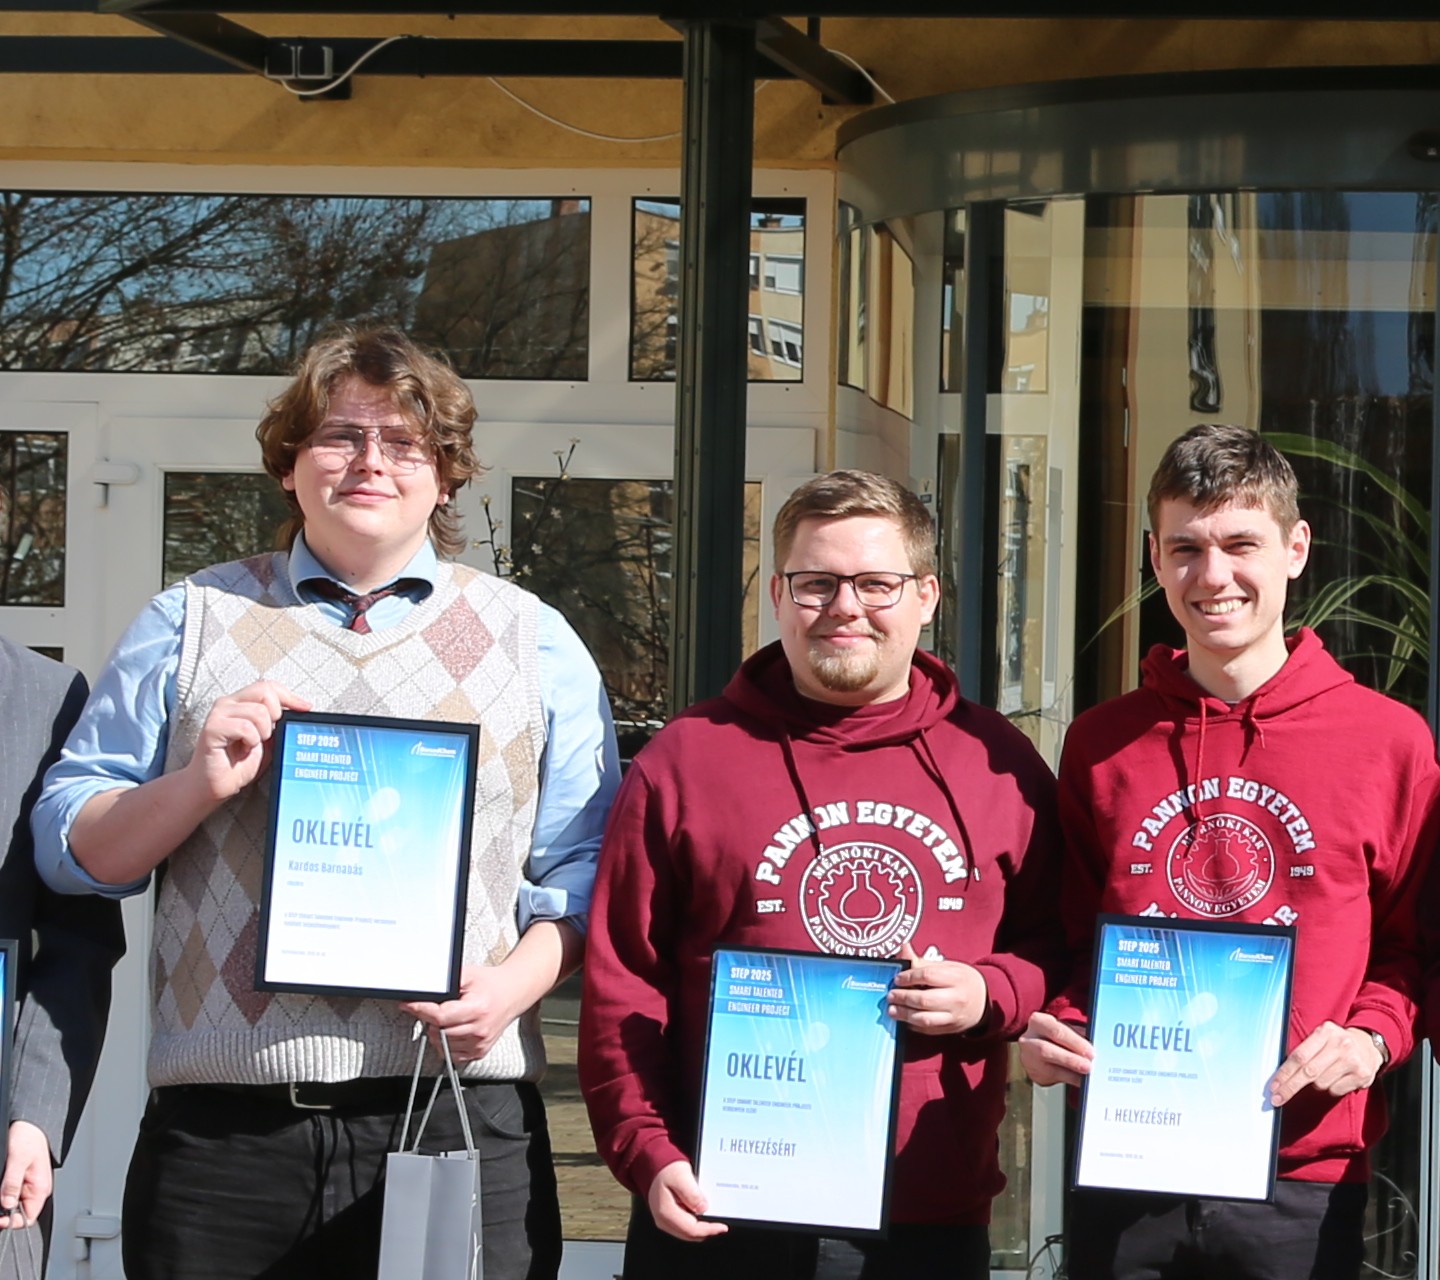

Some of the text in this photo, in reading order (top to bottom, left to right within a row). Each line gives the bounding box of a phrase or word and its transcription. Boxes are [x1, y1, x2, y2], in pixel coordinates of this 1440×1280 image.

[297, 733, 339, 748] STEP 2025
[296, 751, 352, 765] SMART TALENTED
[295, 767, 359, 782] ENGINEER PROJECT
[1227, 776, 1316, 853] EGYETEM
[292, 816, 373, 848] OKLEVÉL
[1243, 827, 1264, 850] KAR
[856, 801, 968, 884] EGYETEM
[882, 853, 909, 878] KAR
[1130, 863, 1153, 874] EST.
[1290, 866, 1314, 877] 1949
[1173, 877, 1212, 912] PANNON
[1214, 878, 1267, 913] EGYETEM
[757, 899, 786, 913] EST.
[938, 898, 964, 910] 1949
[1118, 939, 1160, 953] STEP 2025
[1116, 956, 1171, 971] SMART TALENTED
[731, 967, 772, 981] STEP 2025
[1115, 972, 1178, 987] ENGINEER PROJECT
[729, 985, 783, 998] SMART TALENTED
[727, 1001, 790, 1016] ENGINEER PROJECT
[1113, 1020, 1193, 1052] OKLEVÉL
[726, 1050, 806, 1082] OKLEVÉL
[1104, 1106, 1182, 1127] I. HELYEZÉSÉRT
[719, 1136, 797, 1157] I. HELYEZÉSÉRT
